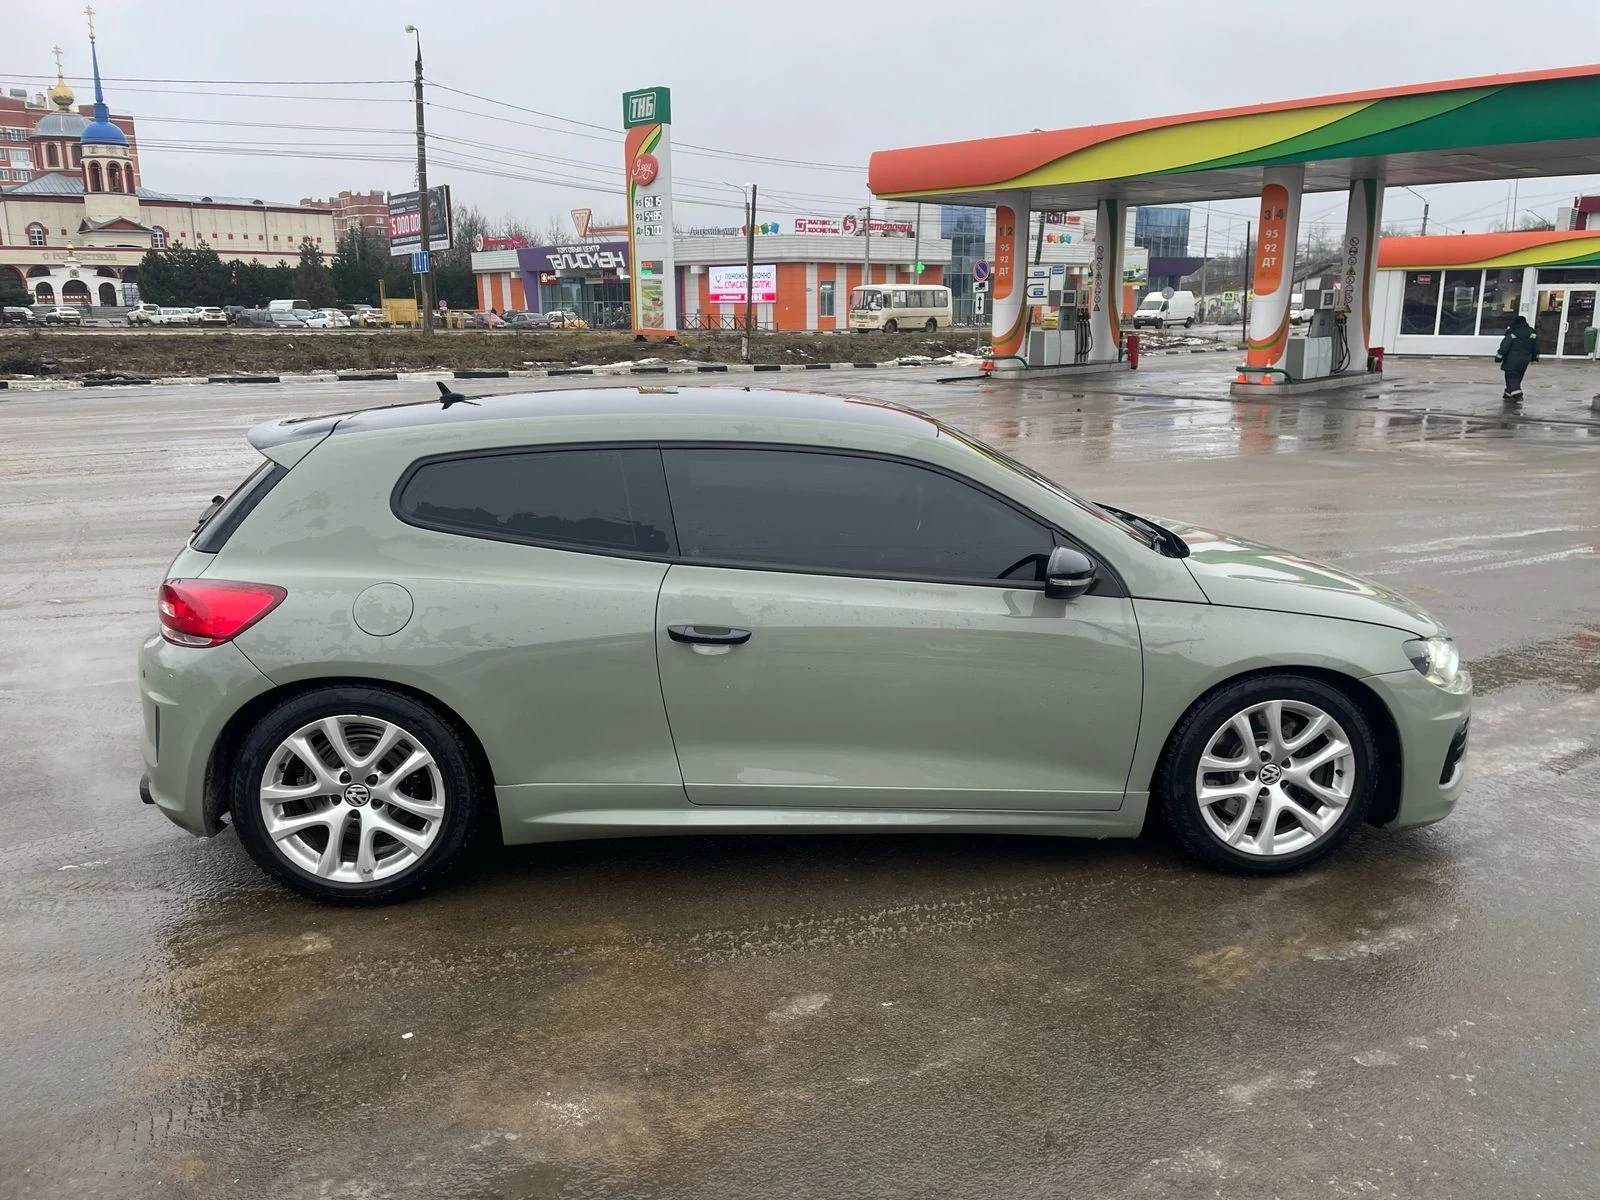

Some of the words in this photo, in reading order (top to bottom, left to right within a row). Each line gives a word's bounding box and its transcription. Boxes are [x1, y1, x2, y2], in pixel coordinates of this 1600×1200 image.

[631, 95, 654, 119] ТНБ
[1265, 229, 1279, 239] 95
[1000, 244, 1010, 252] 95
[1264, 243, 1277, 253] 92
[1262, 257, 1276, 268] ДТ
[998, 267, 1009, 277] ДТ
